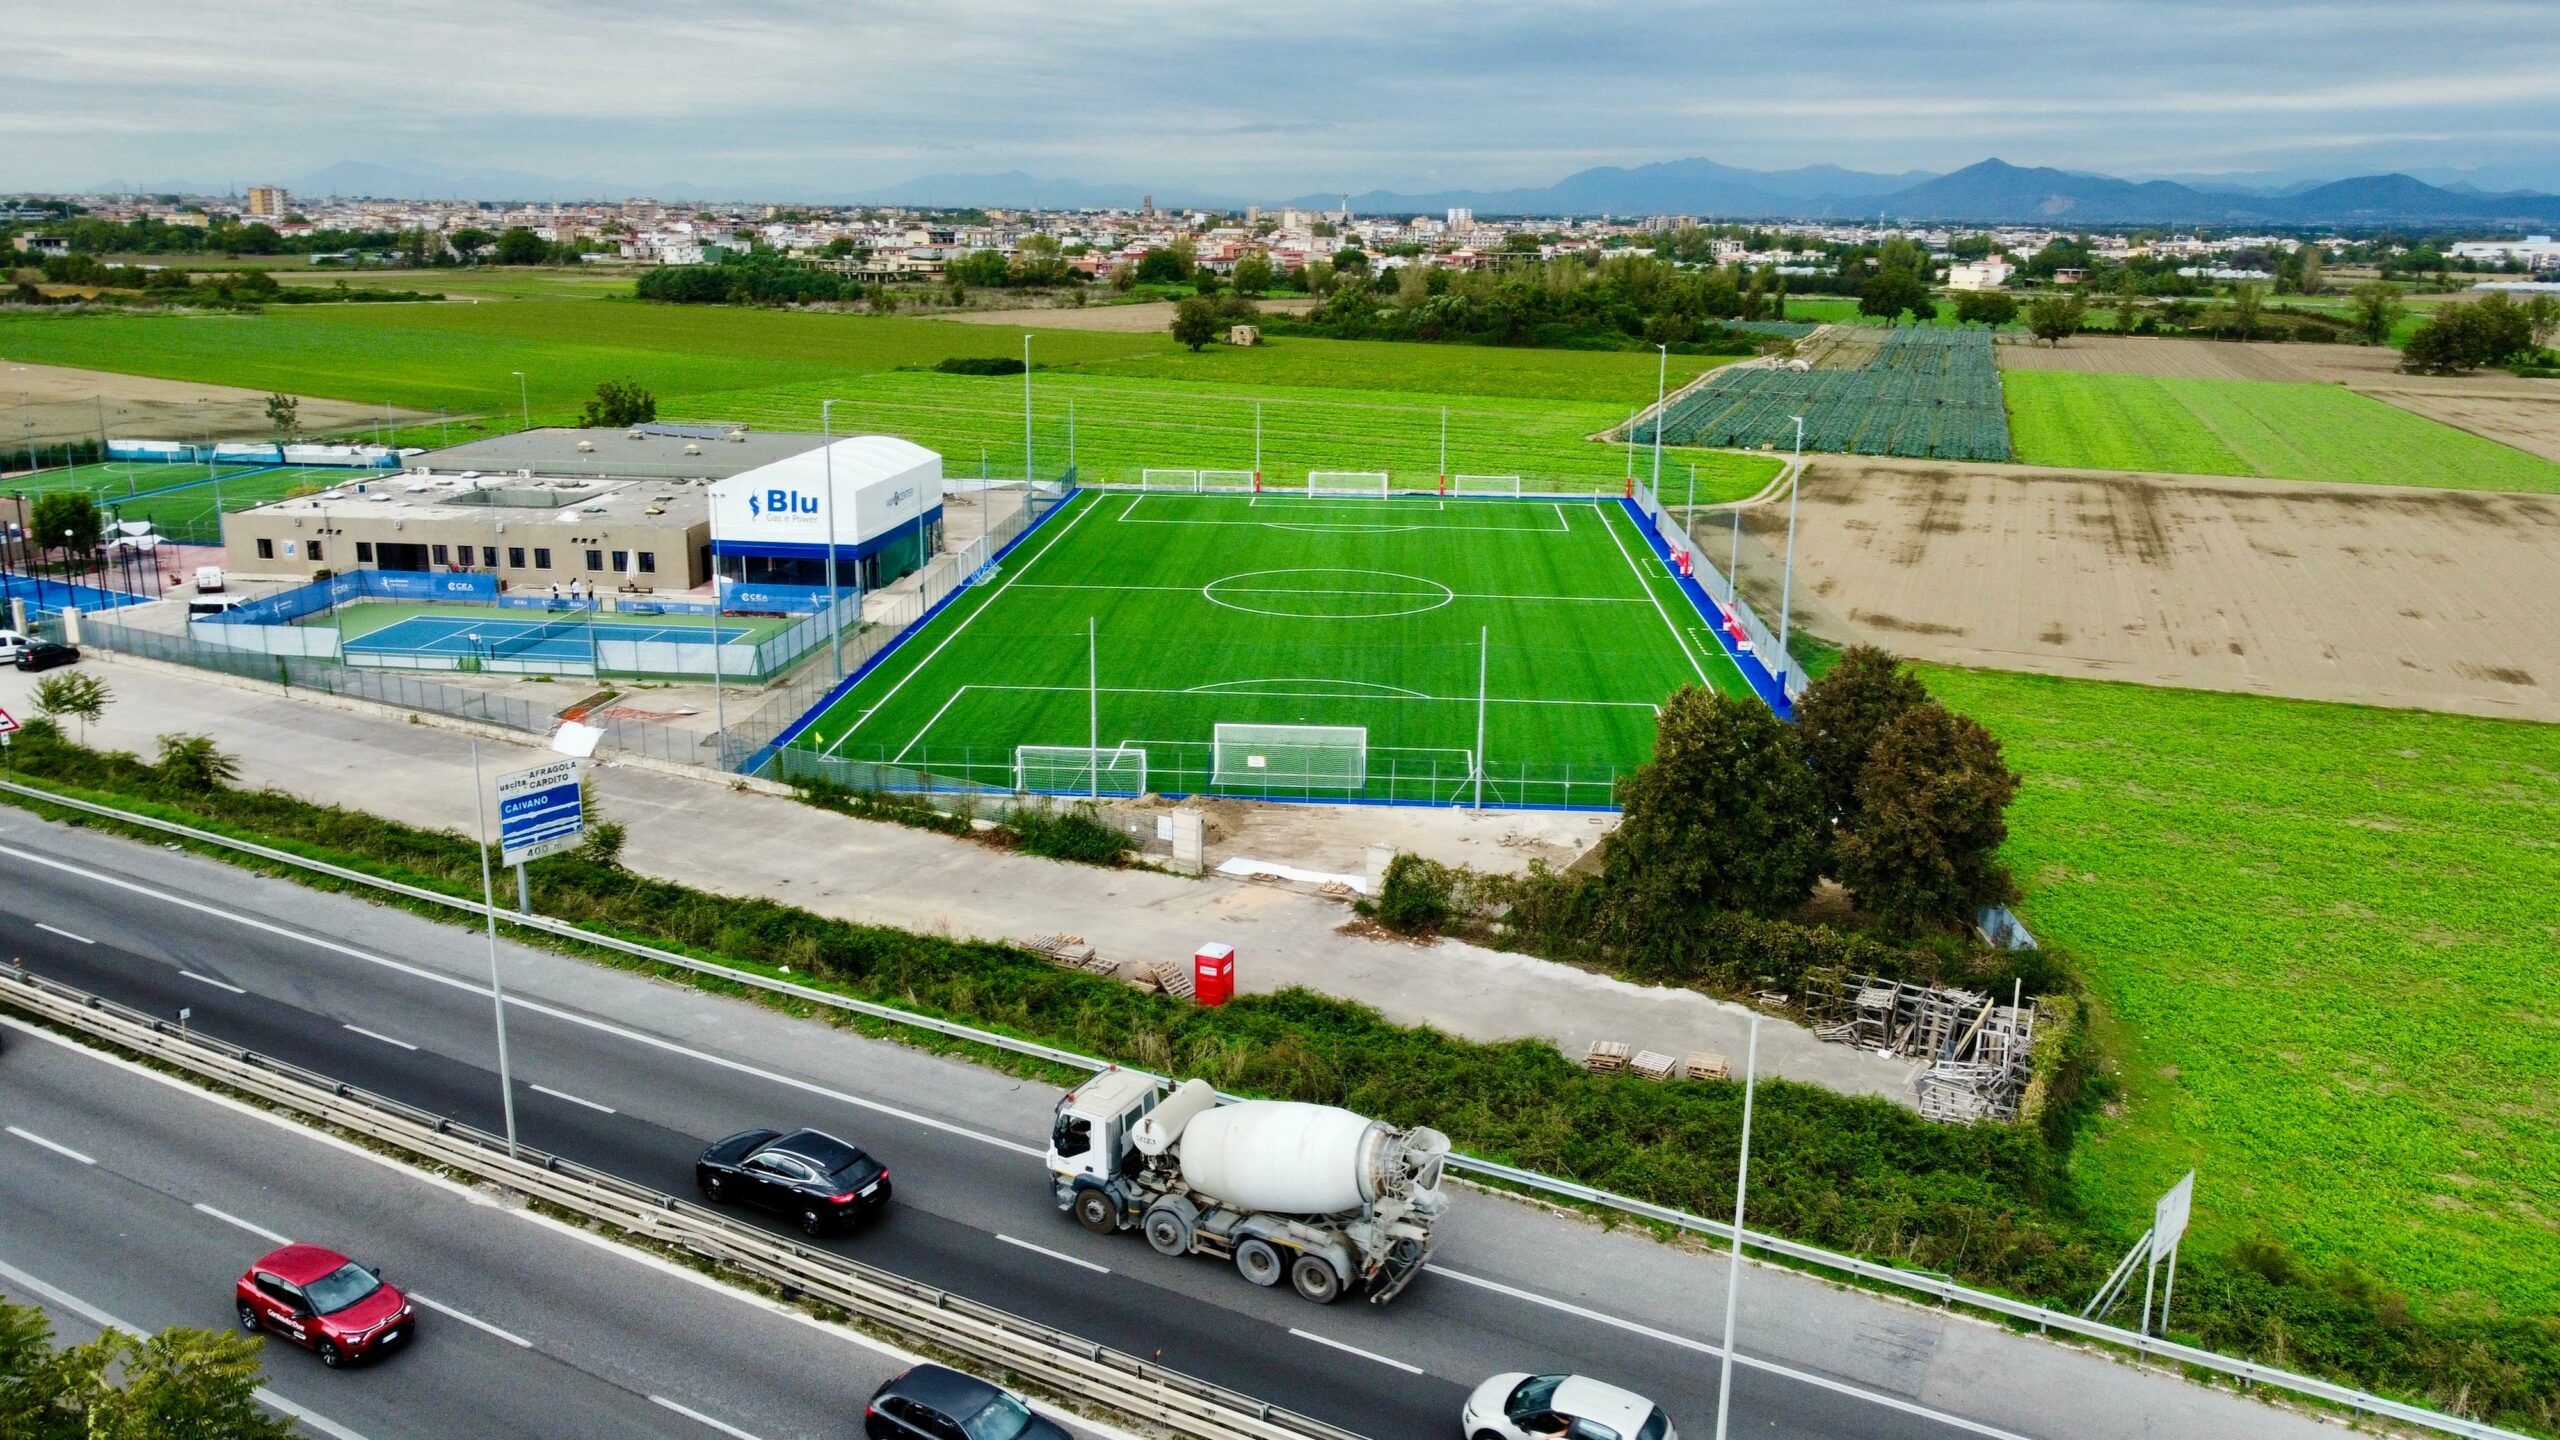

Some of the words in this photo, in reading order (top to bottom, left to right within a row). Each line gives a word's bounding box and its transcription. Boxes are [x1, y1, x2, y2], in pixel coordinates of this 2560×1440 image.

[767, 489, 818, 514] Blu
[766, 513, 782, 522] Gas
[792, 514, 818, 524] Power
[529, 761, 577, 779] AFRAGOLA
[499, 779, 526, 791] uscita
[529, 773, 569, 789] CARDITO
[505, 795, 549, 814] CAIVANO
[526, 845, 549, 857] 400
